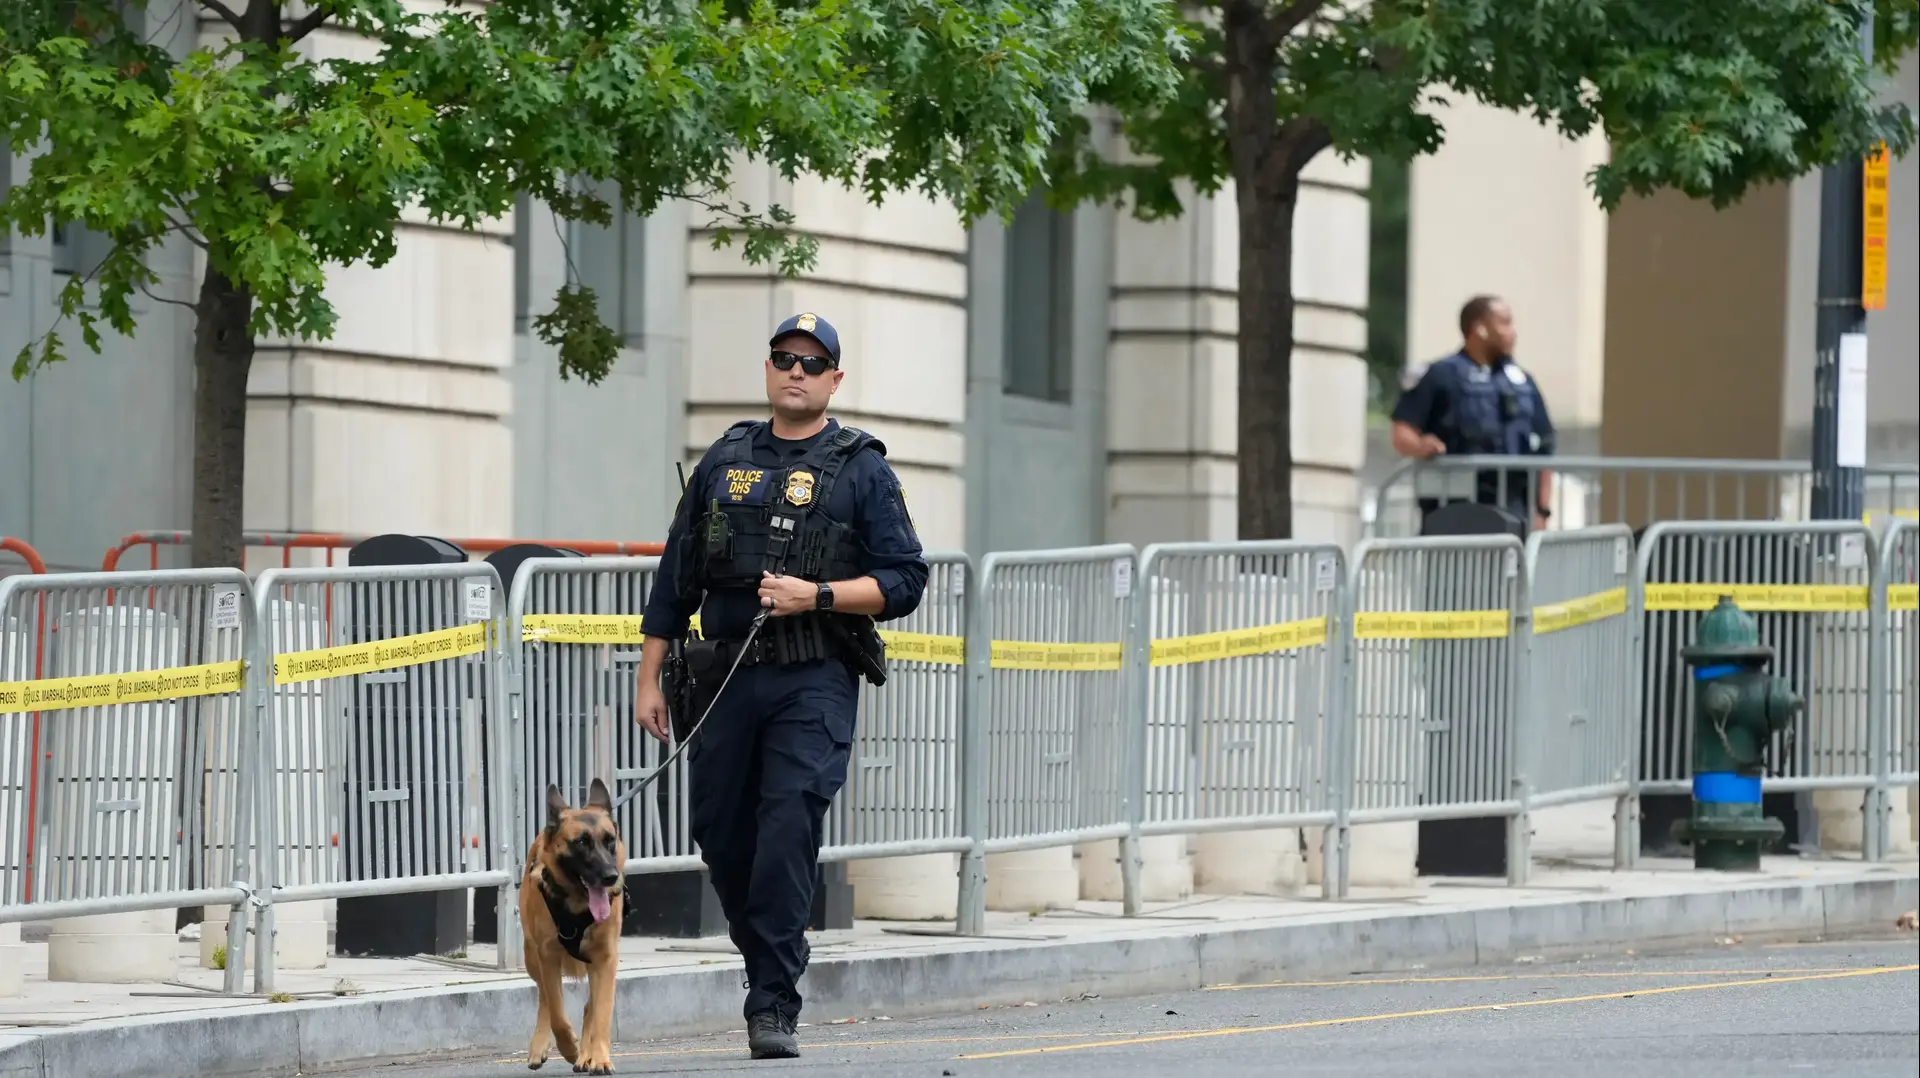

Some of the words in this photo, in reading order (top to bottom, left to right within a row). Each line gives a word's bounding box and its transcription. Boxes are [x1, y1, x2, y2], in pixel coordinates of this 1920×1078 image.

[726, 469, 763, 482] POLICE
[729, 481, 751, 494] DHS
[585, 624, 592, 635] DO
[593, 624, 602, 635] NOT
[602, 624, 618, 635] CROSS
[295, 661, 304, 674] U.S.
[305, 659, 328, 673] MARSHAL
[334, 656, 341, 669] DO
[342, 654, 352, 667] NOT
[352, 652, 369, 665] CROSS
[381, 647, 390, 661] U.S.
[391, 644, 413, 659] MARSHAL
[419, 643, 425, 655] DO
[426, 641, 436, 653] NOT
[436, 638, 452, 652] CROSS
[0, 691, 17, 705] ROSS
[31, 690, 40, 702] U.S.
[41, 688, 66, 702] MARSHAL
[73, 686, 81, 699] DO
[82, 685, 93, 698] NOT
[93, 684, 111, 697] CROSS
[123, 682, 132, 694] U.S.
[133, 680, 157, 694] MARSHAL
[164, 678, 171, 691] DO
[172, 677, 182, 690] NOT
[183, 675, 199, 688] CROSS
[211, 673, 220, 685] U.S.
